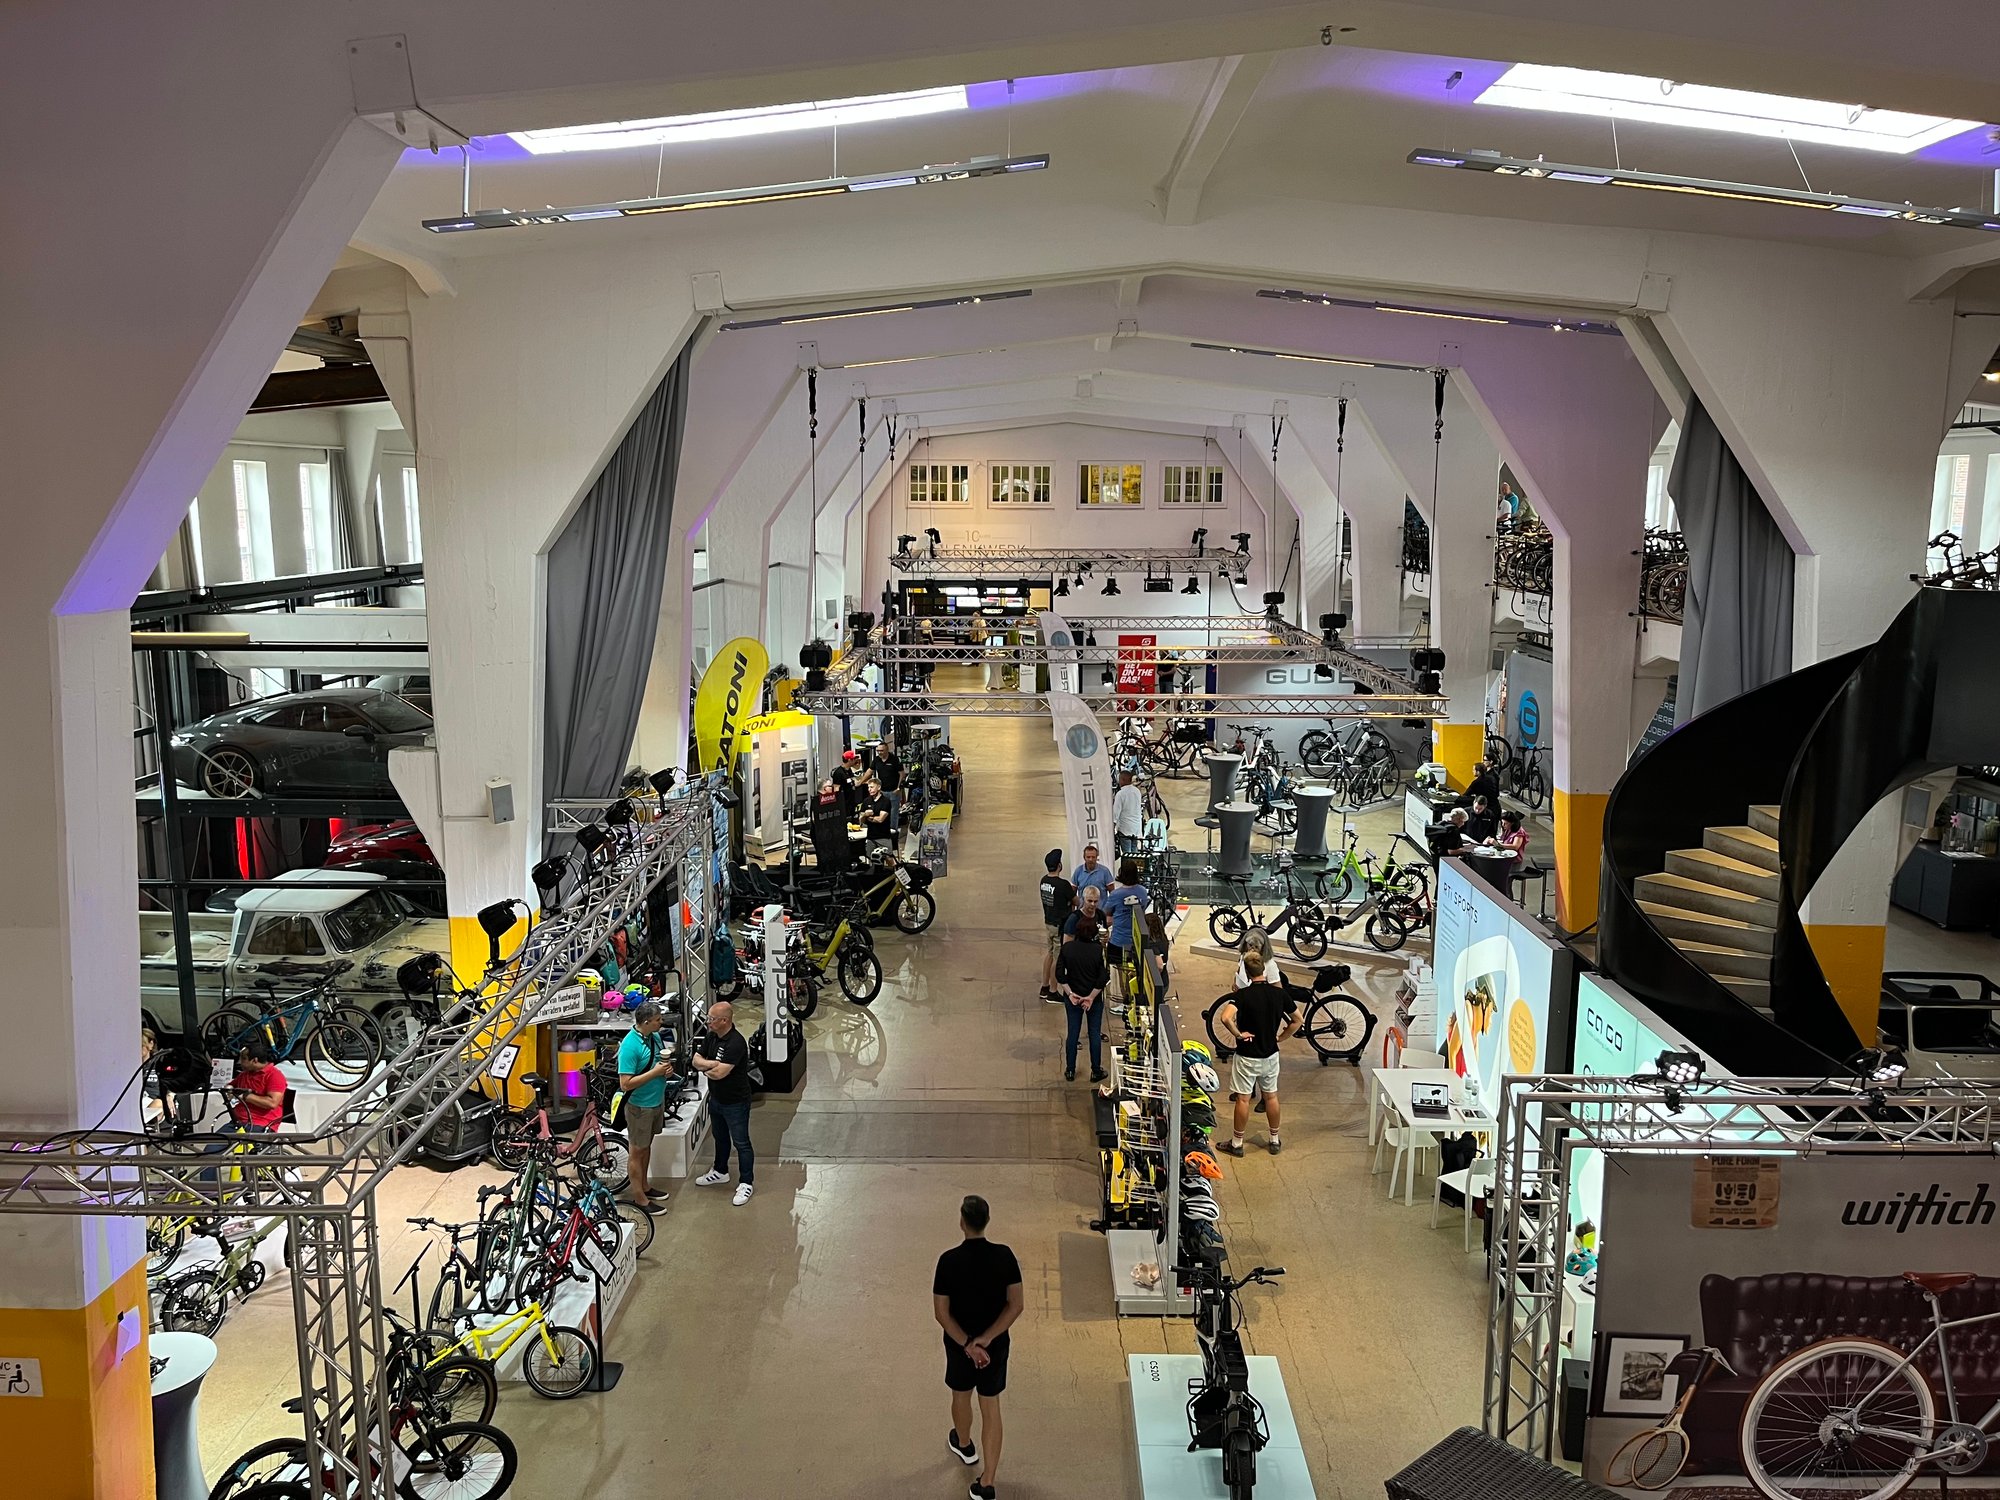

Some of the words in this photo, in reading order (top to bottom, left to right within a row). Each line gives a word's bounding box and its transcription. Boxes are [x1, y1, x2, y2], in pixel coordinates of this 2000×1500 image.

[743, 718, 776, 732] TONI
[1453, 892, 1479, 924] SPORTS
[1150, 1360, 1160, 1382] CS200
